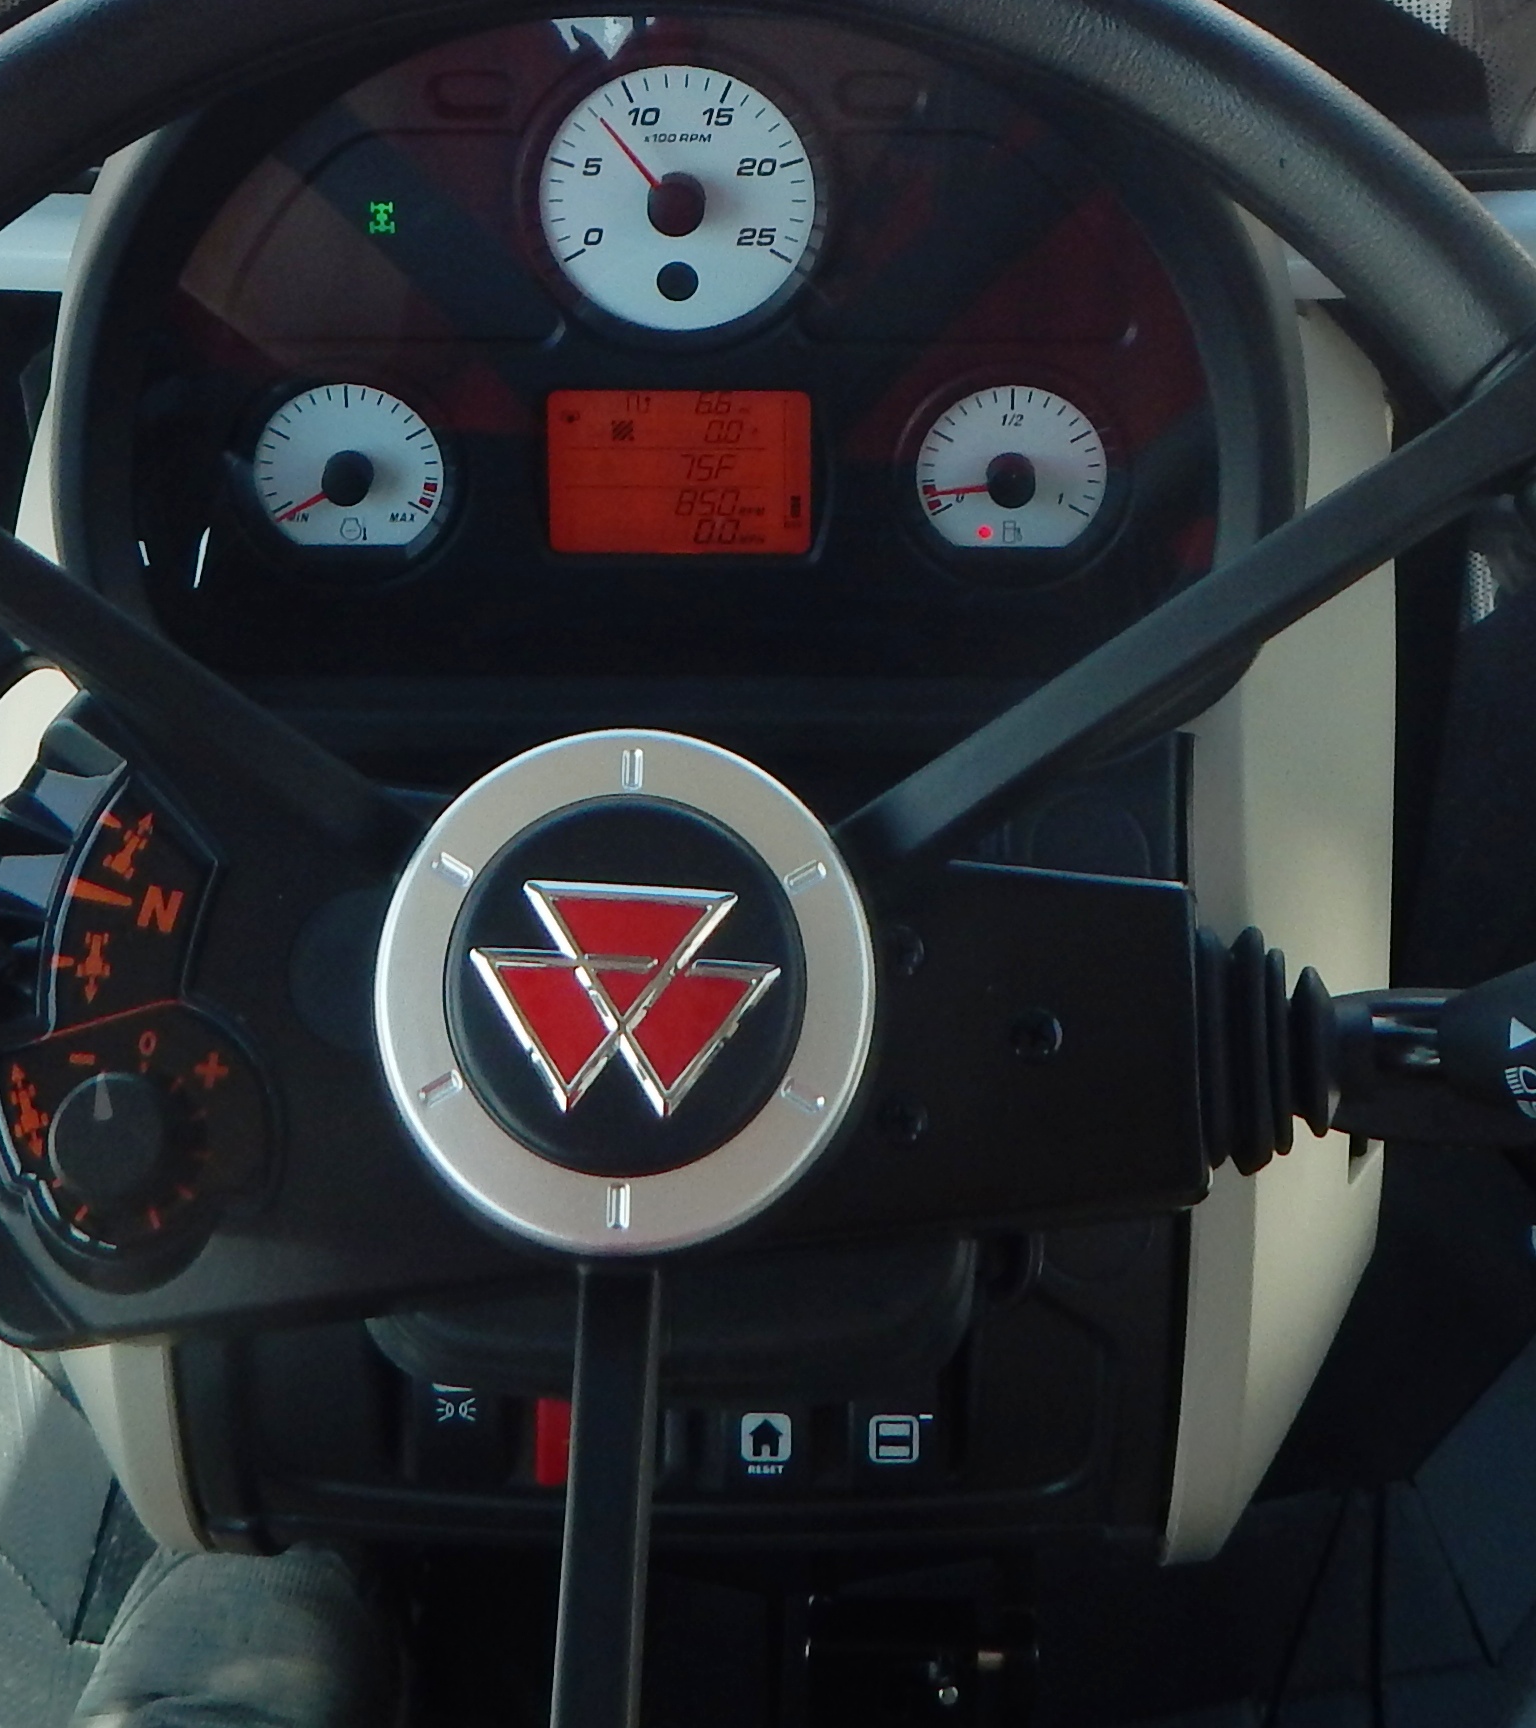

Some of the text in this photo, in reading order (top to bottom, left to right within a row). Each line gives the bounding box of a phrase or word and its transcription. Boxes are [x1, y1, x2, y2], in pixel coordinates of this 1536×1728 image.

[627, 107, 661, 126] 10
[702, 107, 735, 126] 15
[679, 132, 712, 143] RPM
[582, 157, 603, 177] 5
[736, 157, 777, 177] 20
[583, 227, 604, 247] 0
[736, 227, 777, 247] 25
[1001, 413, 1024, 427] 1/2
[674, 488, 740, 517] 850
[389, 511, 417, 523] MAX
[137, 884, 184, 934] N
